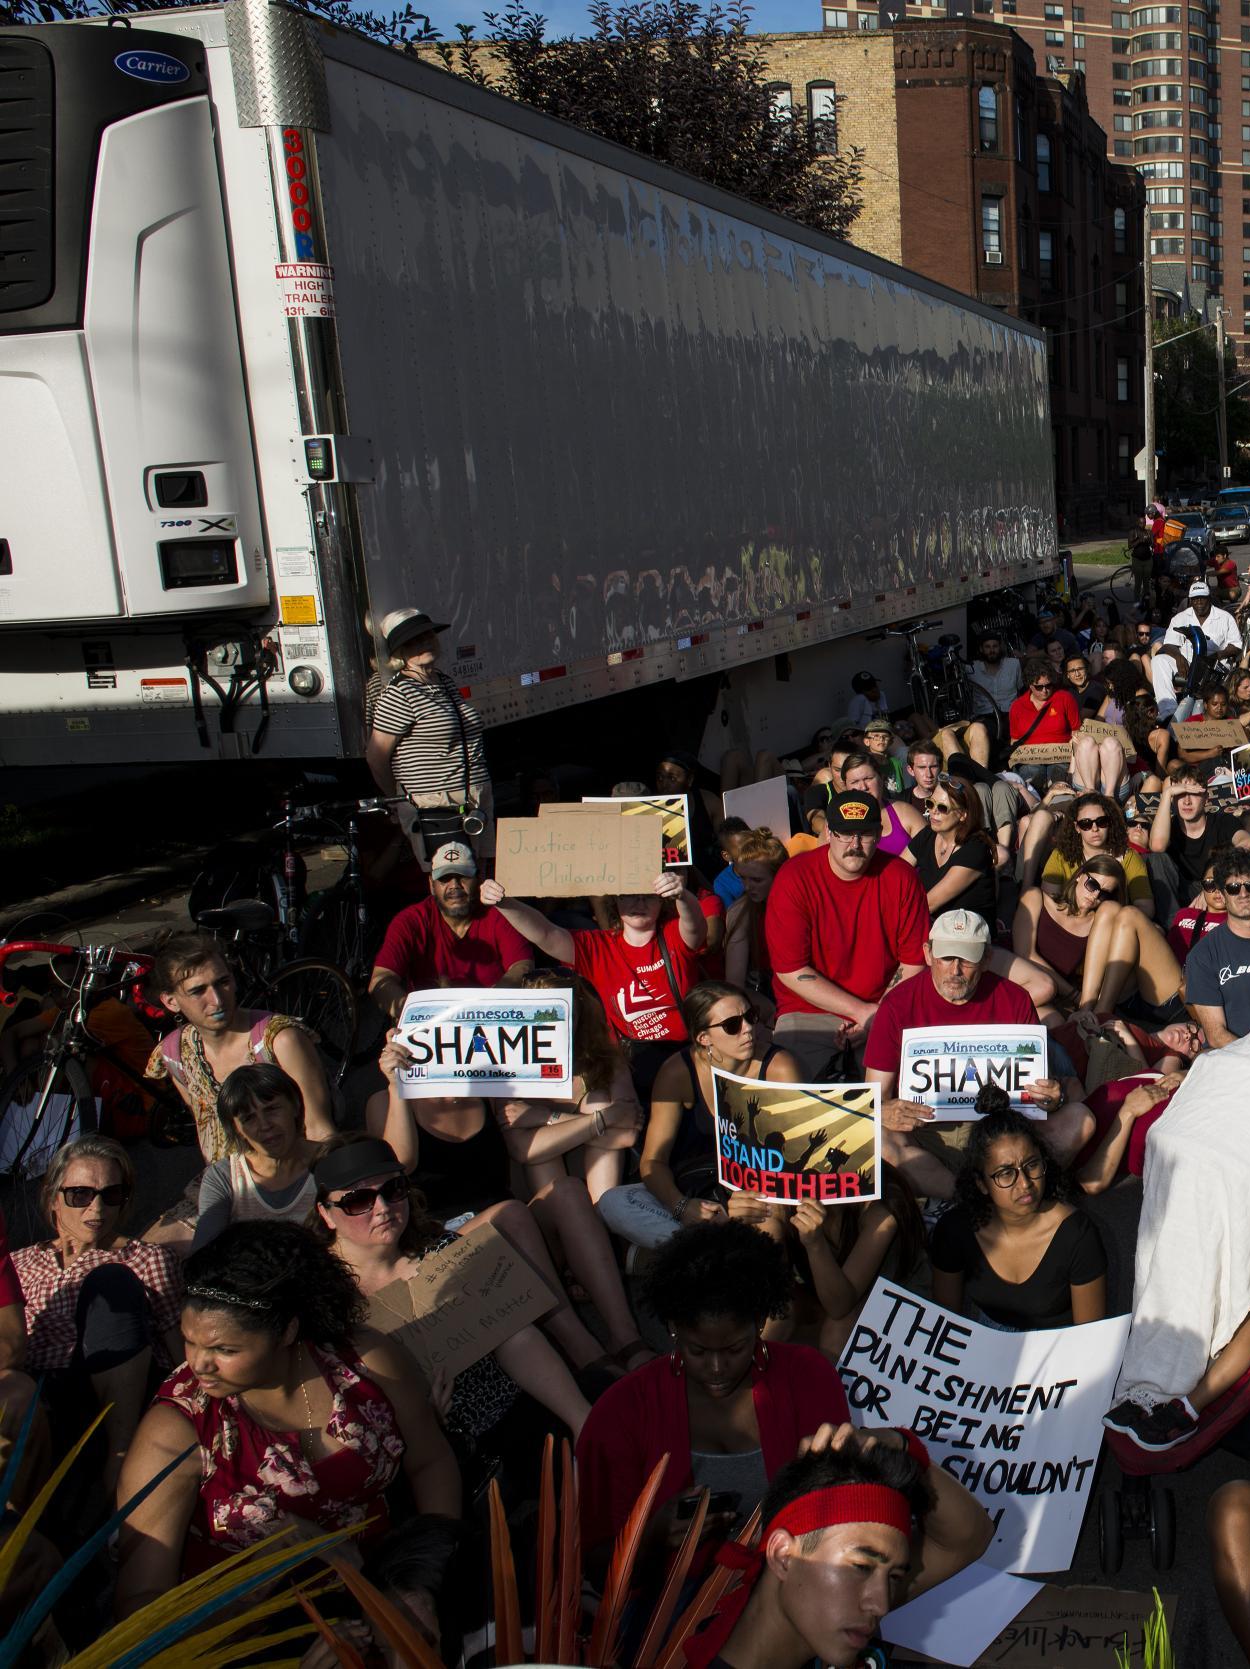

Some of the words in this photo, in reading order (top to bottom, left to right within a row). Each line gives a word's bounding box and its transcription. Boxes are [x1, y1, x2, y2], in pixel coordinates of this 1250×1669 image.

[125, 56, 181, 76] Carrier
[283, 128, 314, 258] 3000R
[295, 281, 324, 290] HIGH
[509, 829, 576, 855] Justice
[539, 861, 616, 889] Philando
[407, 1024, 558, 1065] SHAME
[943, 1041, 1009, 1053] Minnesota
[407, 1067, 426, 1079] JUL
[488, 1070, 517, 1078] lakes
[909, 1057, 1035, 1094] SHAME
[718, 1115, 737, 1140] we
[722, 1135, 785, 1173] STAND
[720, 1156, 862, 1201] TOGETHER
[882, 1288, 973, 1366] THE
[842, 1324, 1078, 1415] PUNISHMENT
[838, 1367, 892, 1422] FOR
[909, 1405, 1025, 1451] BEING
[940, 1454, 1095, 1496] SHOULDN'T
